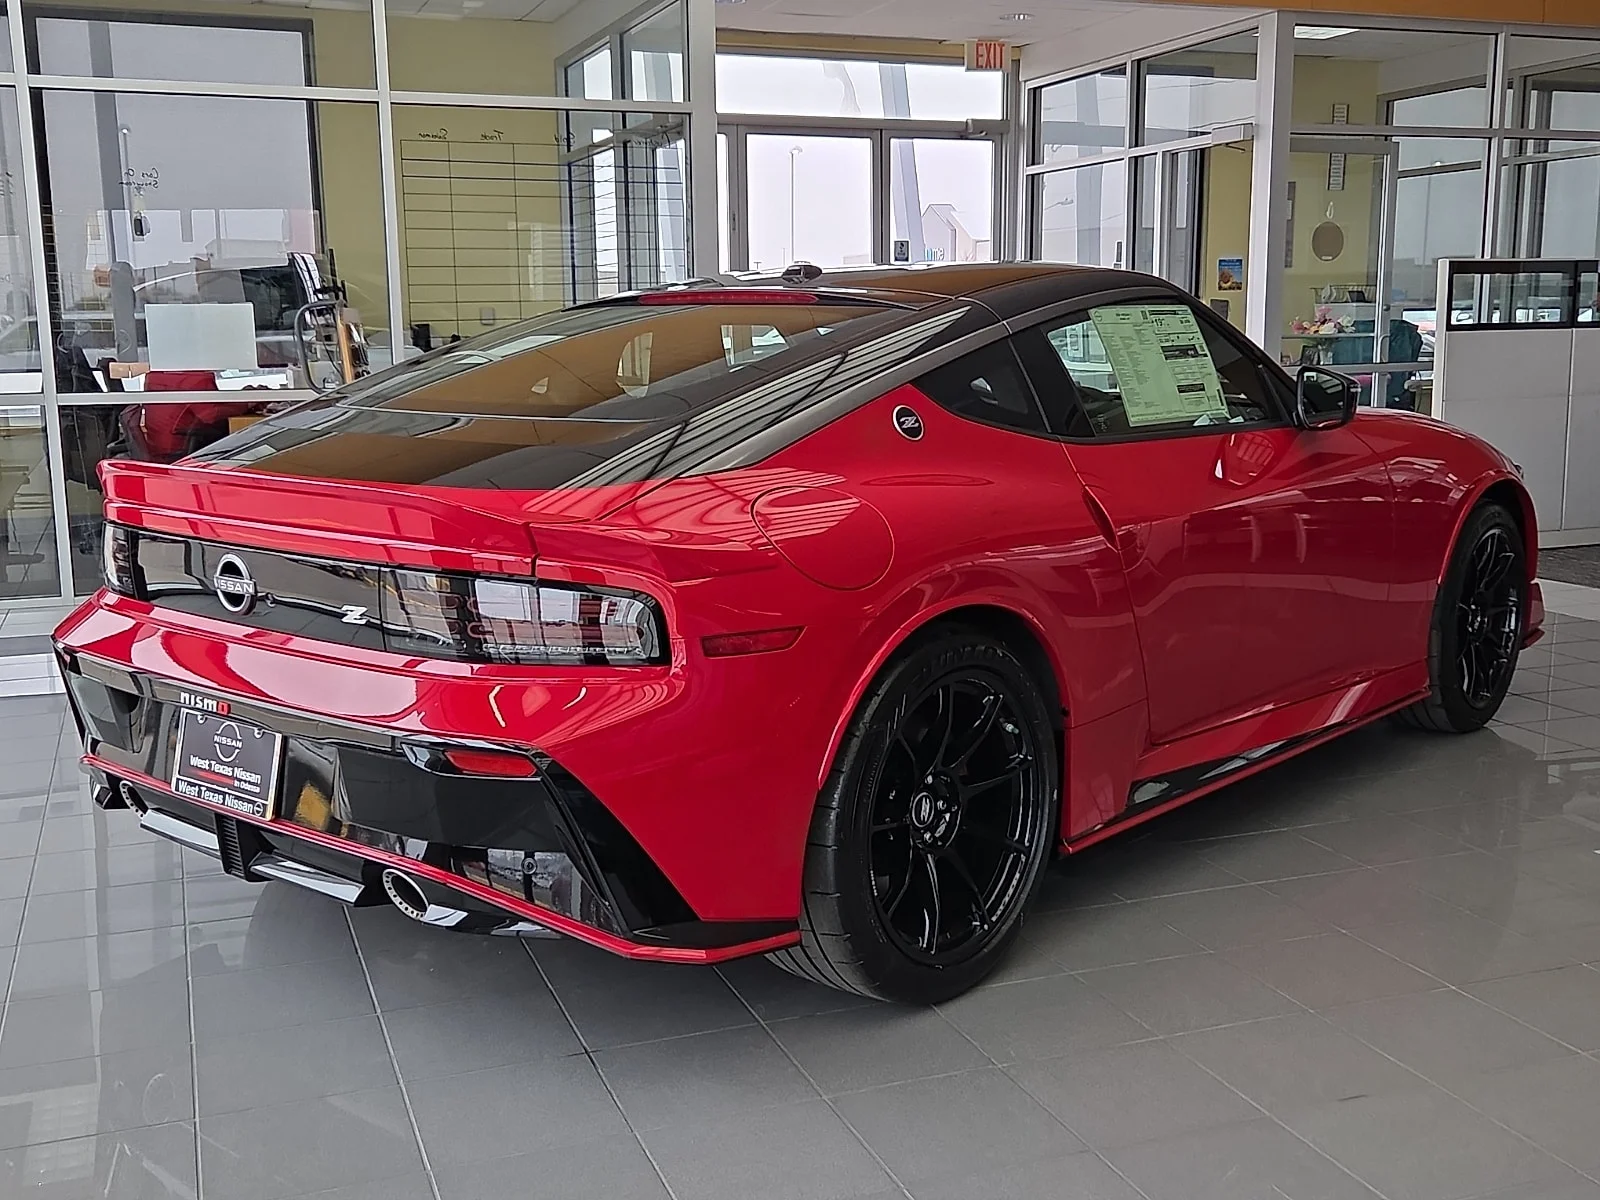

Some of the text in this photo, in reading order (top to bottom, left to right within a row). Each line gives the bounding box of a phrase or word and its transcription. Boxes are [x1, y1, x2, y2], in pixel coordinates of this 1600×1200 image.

[975, 42, 1005, 69] EXIT
[340, 604, 369, 625] Z
[180, 691, 231, 716] nismo
[213, 734, 243, 749] NISSAN
[189, 754, 262, 785] West Texas Nissan
[177, 779, 254, 814] West Texas Nissan
